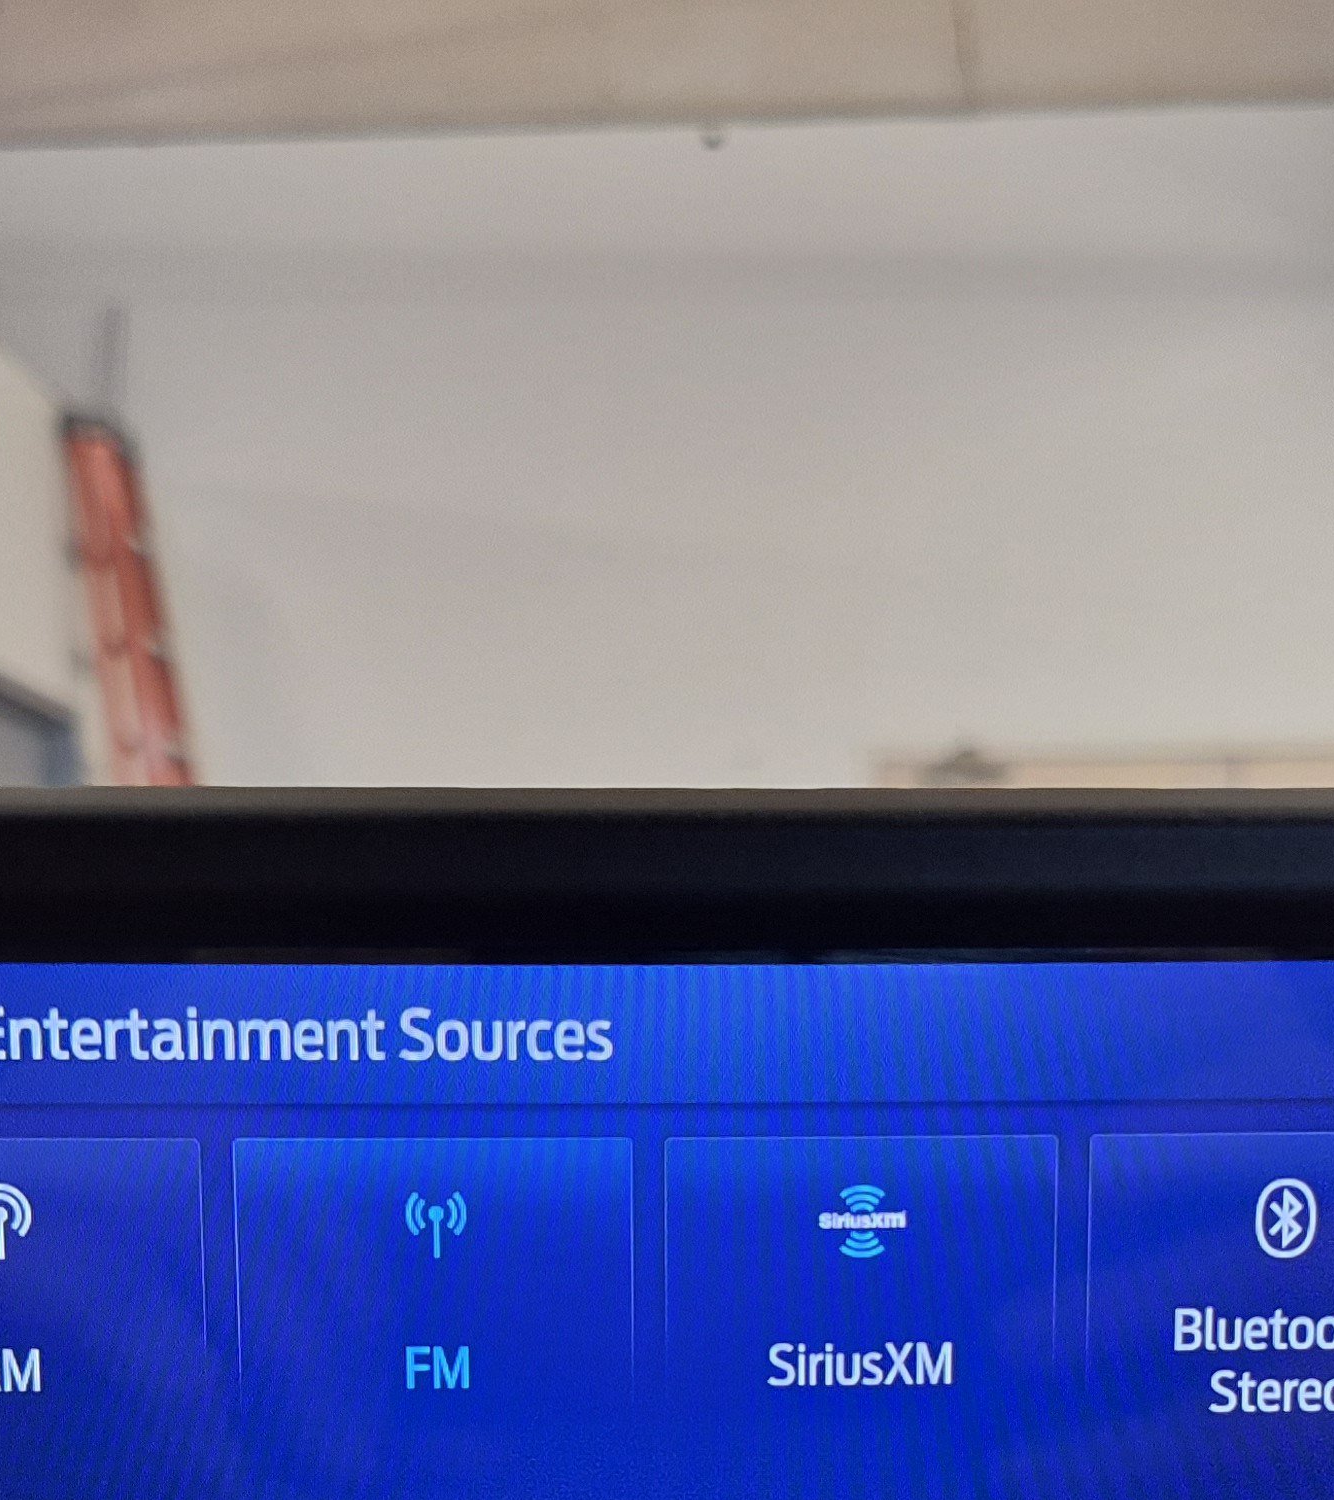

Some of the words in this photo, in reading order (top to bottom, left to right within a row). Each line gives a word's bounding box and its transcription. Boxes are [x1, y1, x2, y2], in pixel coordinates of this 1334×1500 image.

[398, 1006, 614, 1062] Sources
[405, 1345, 470, 1390] FM
[767, 1341, 953, 1387] SiriusXM
